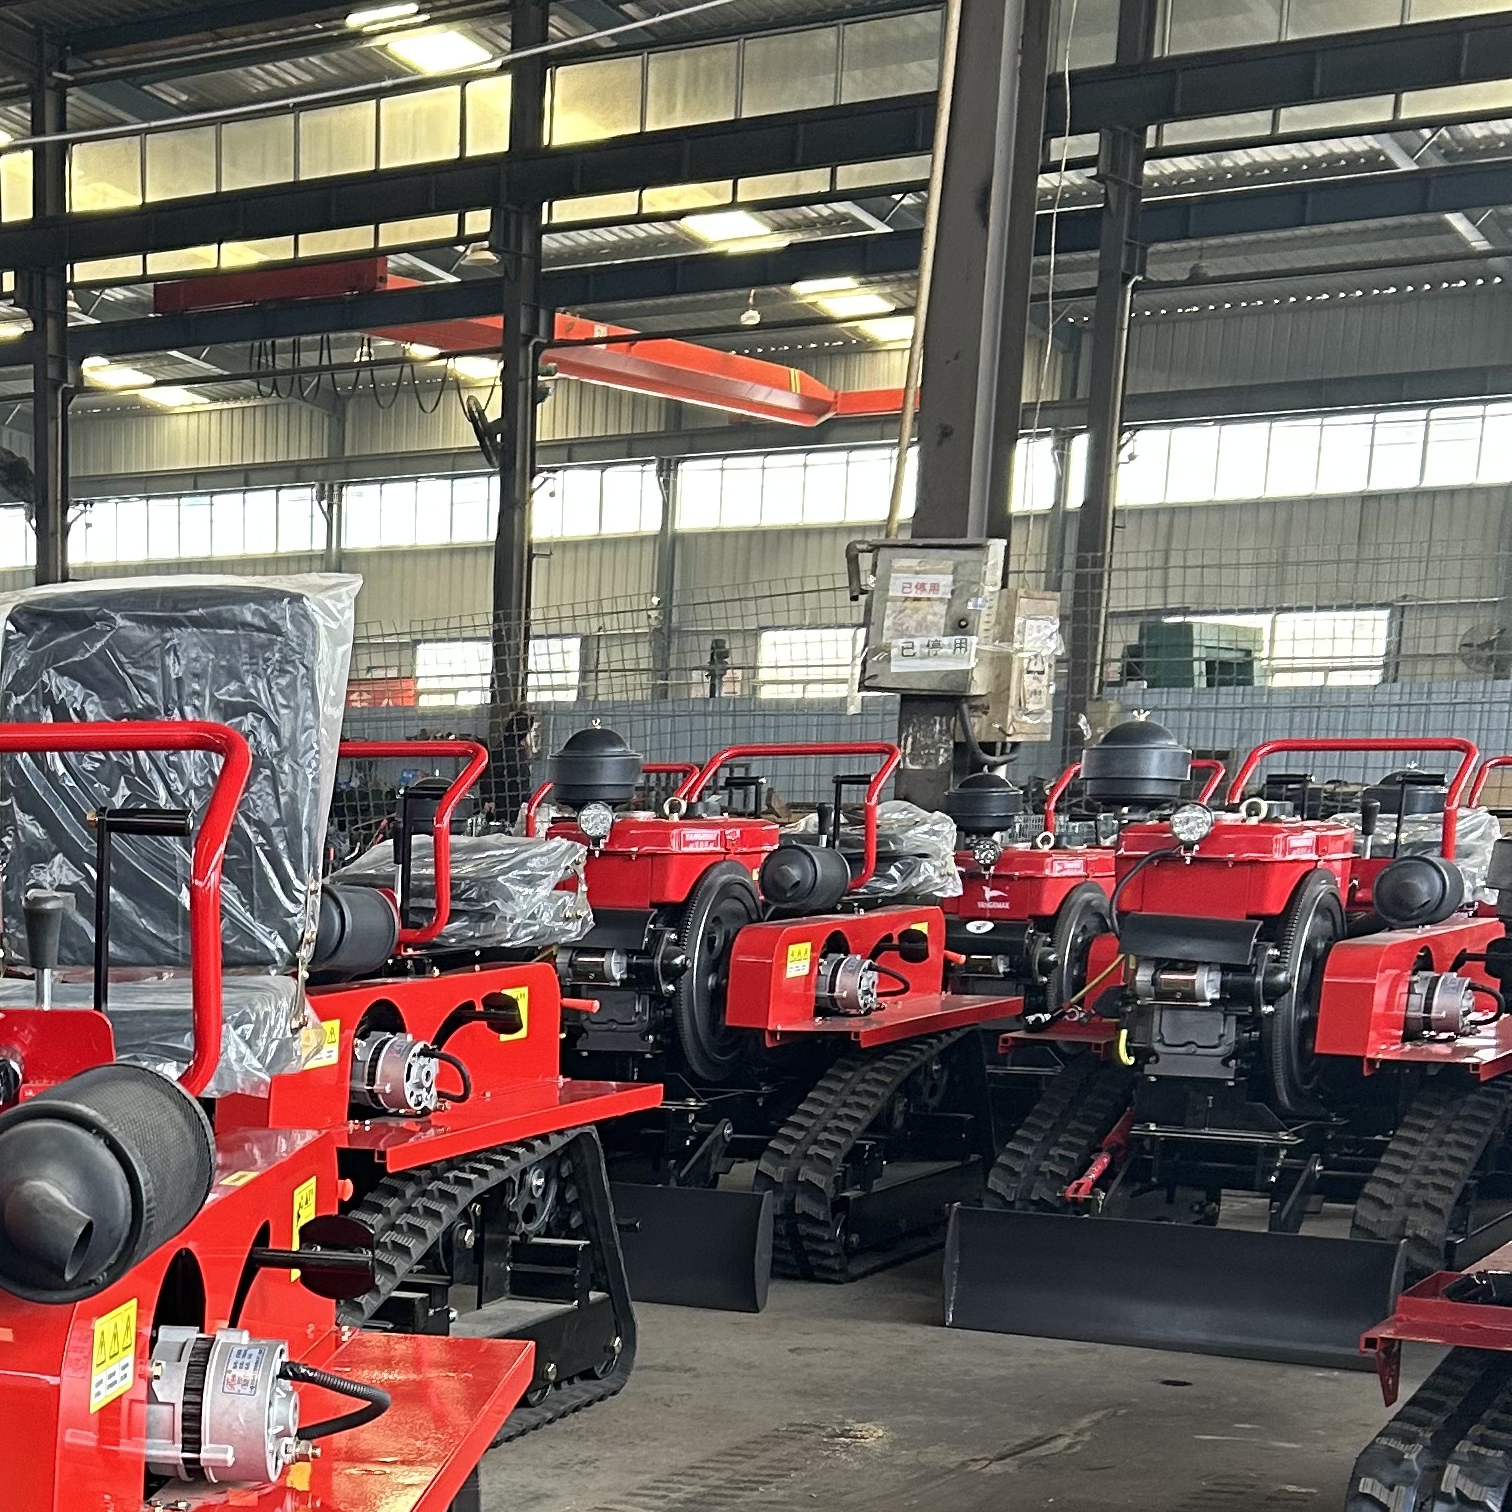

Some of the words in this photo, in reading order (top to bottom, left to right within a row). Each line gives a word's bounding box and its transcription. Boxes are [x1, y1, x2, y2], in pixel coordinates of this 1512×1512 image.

[901, 581, 941, 595] 已停用
[900, 637, 968, 658] 已停用
